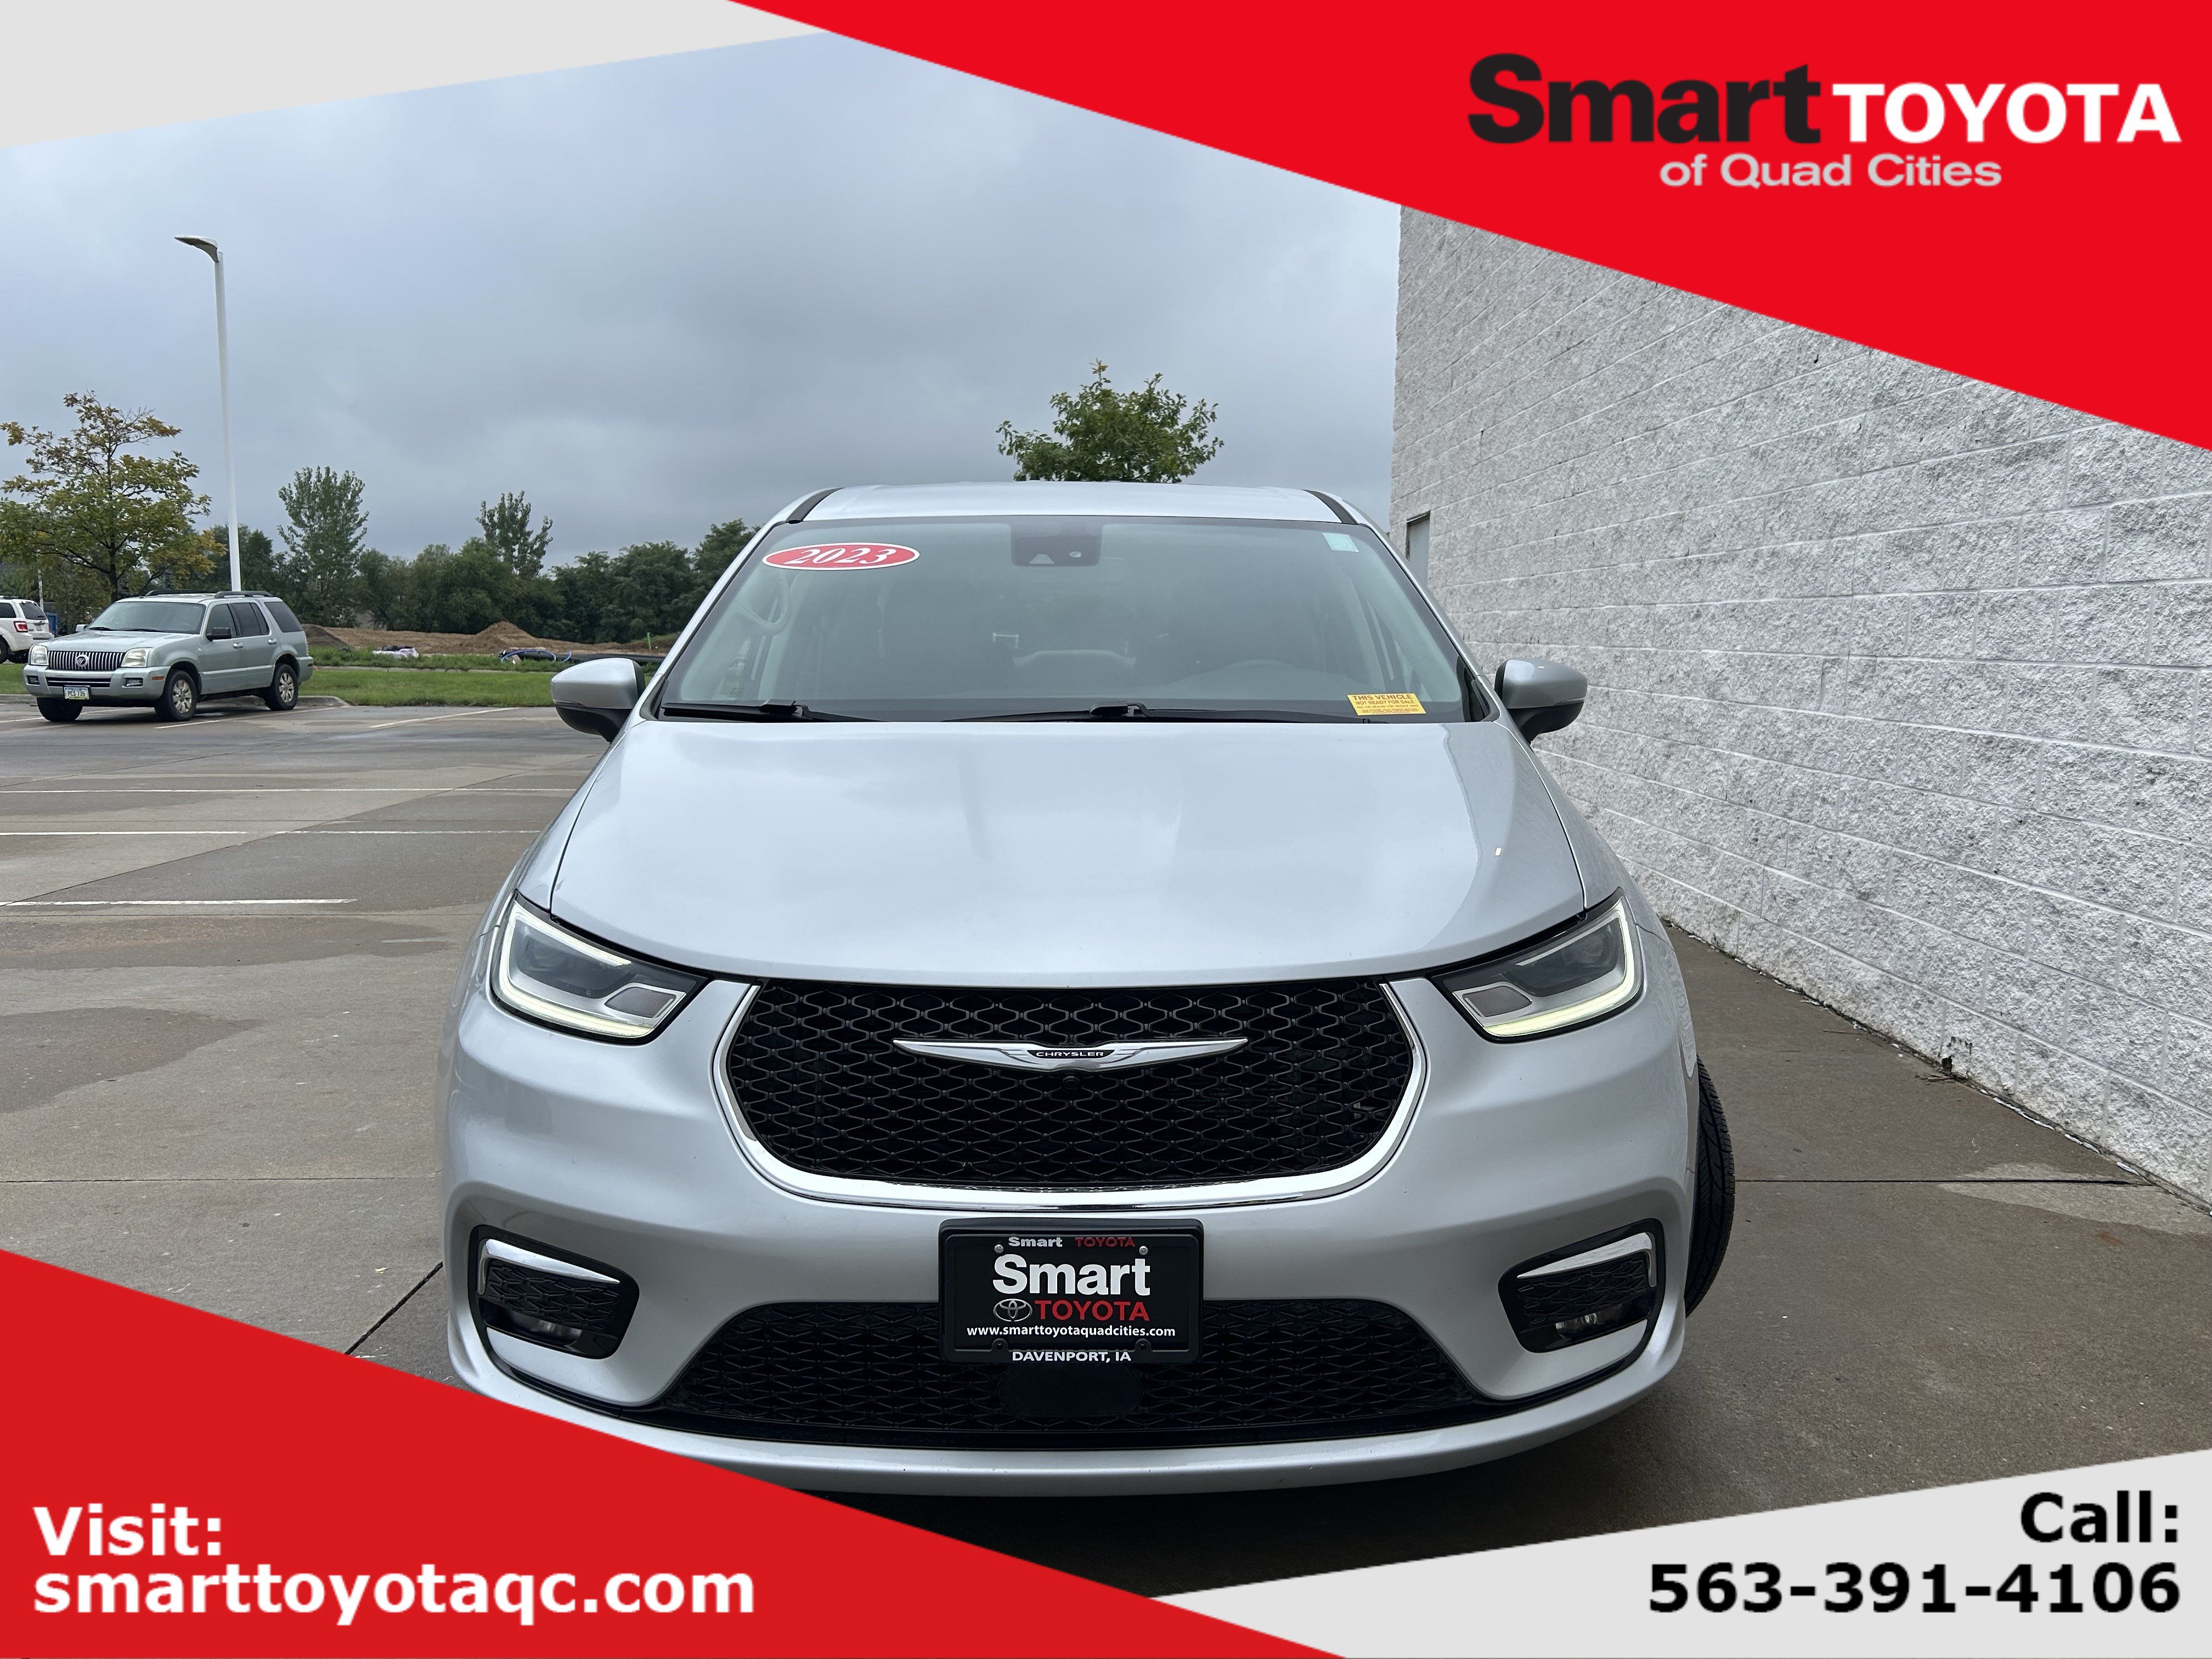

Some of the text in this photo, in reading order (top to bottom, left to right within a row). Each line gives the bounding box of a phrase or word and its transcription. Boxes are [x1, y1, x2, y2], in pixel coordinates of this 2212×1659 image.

[783, 548, 897, 565] 2023
[1008, 1237, 1135, 1248] Smart TOYOTA
[992, 1254, 1150, 1296] Smart
[1035, 1299, 1150, 1321] TOYOTA
[967, 1325, 1176, 1338] www.smarttoyotaquadcities.com
[1012, 1351, 1132, 1363] DAVENPORT, IA
